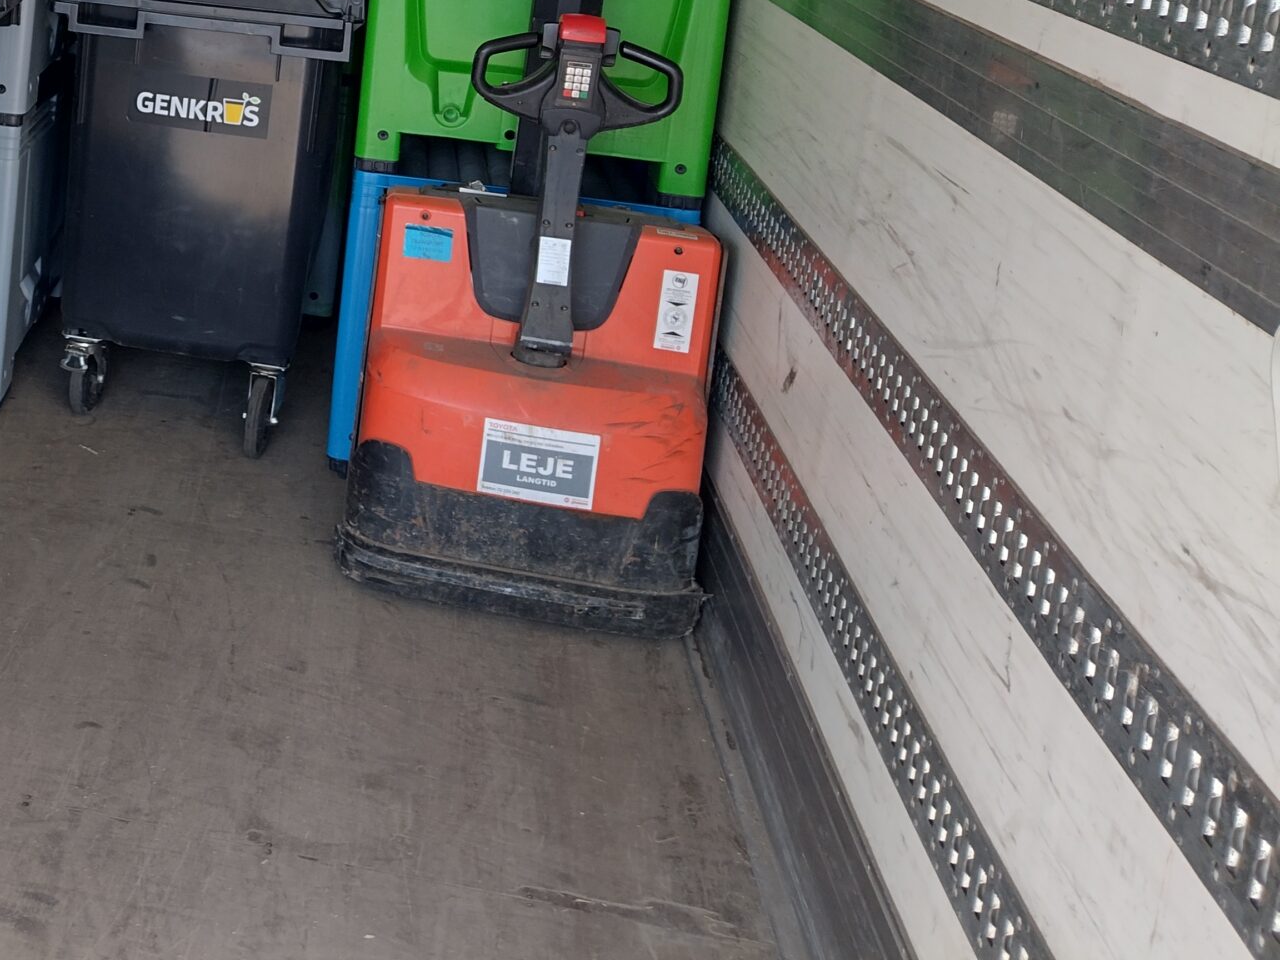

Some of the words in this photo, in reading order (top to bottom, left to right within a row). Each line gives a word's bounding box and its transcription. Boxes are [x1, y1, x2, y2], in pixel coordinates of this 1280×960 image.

[488, 421, 519, 433] TOYOTA
[502, 449, 574, 479] LEJE
[516, 474, 557, 487] LANGTID
